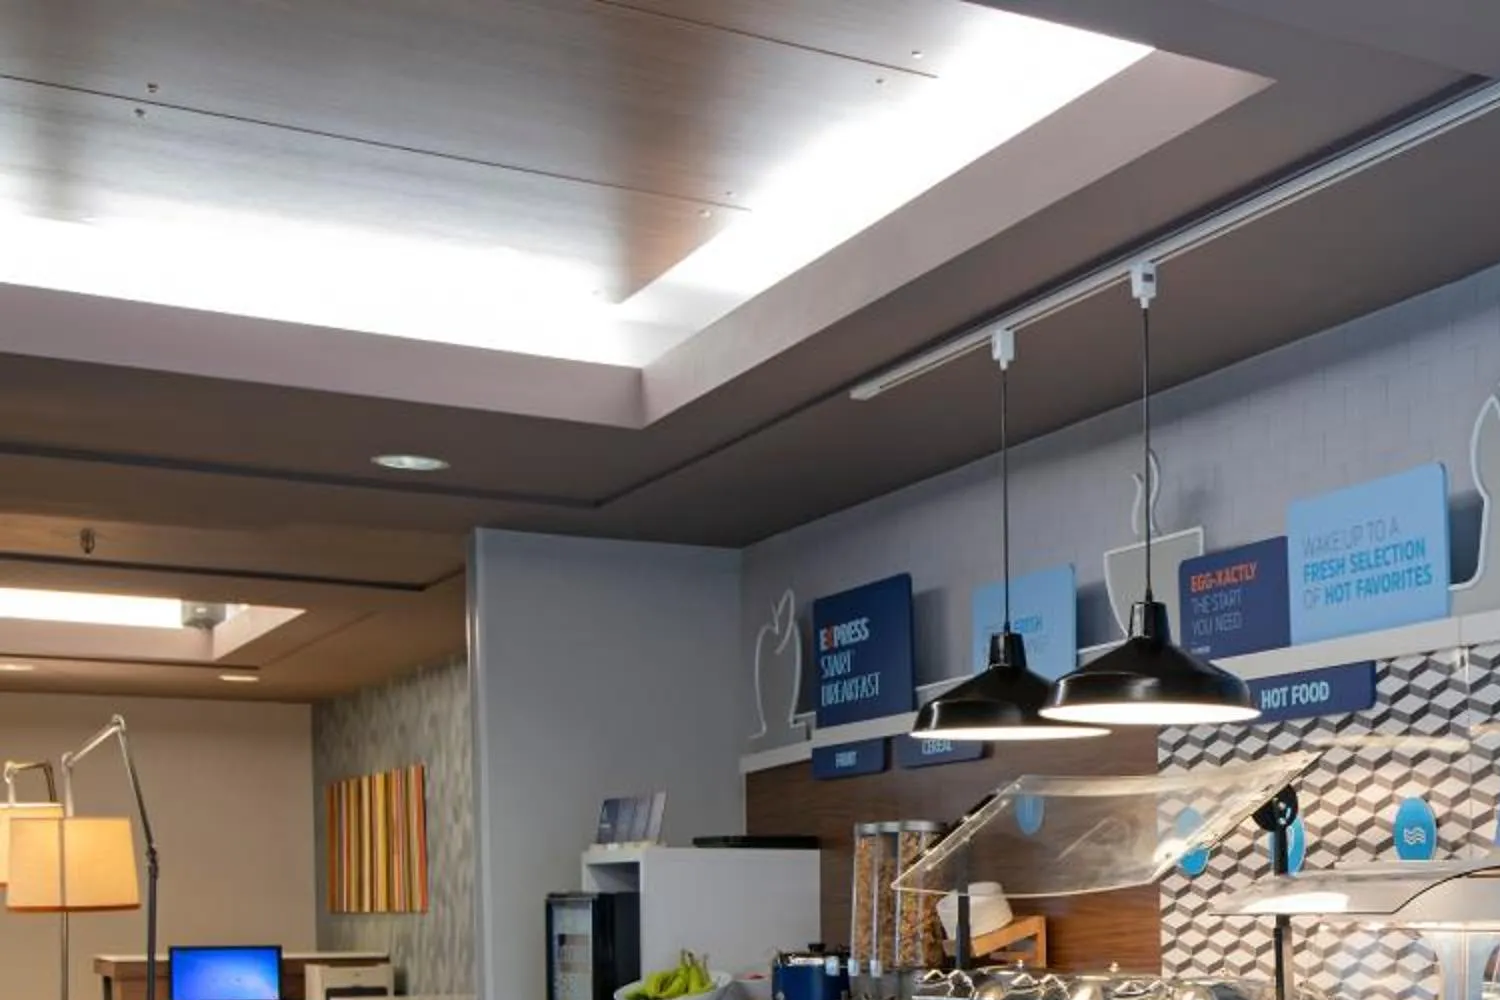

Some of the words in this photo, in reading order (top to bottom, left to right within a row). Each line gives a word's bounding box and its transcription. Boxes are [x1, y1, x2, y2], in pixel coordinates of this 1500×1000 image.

[1304, 530, 1341, 556] WAKE
[1343, 525, 1364, 548] UP
[1367, 520, 1387, 543] TO
[1388, 517, 1400, 538] A
[1191, 562, 1257, 591] EGG-XACTLY
[1304, 561, 1345, 583] FRESH
[1350, 538, 1425, 574] SELECTION
[1304, 588, 1322, 610] OF
[1325, 580, 1352, 604] HOT
[1356, 564, 1433, 597] FAVORITES
[819, 617, 869, 650] EXPRESS
[1261, 687, 1287, 709] HOT
[1292, 682, 1330, 705] FOOD
